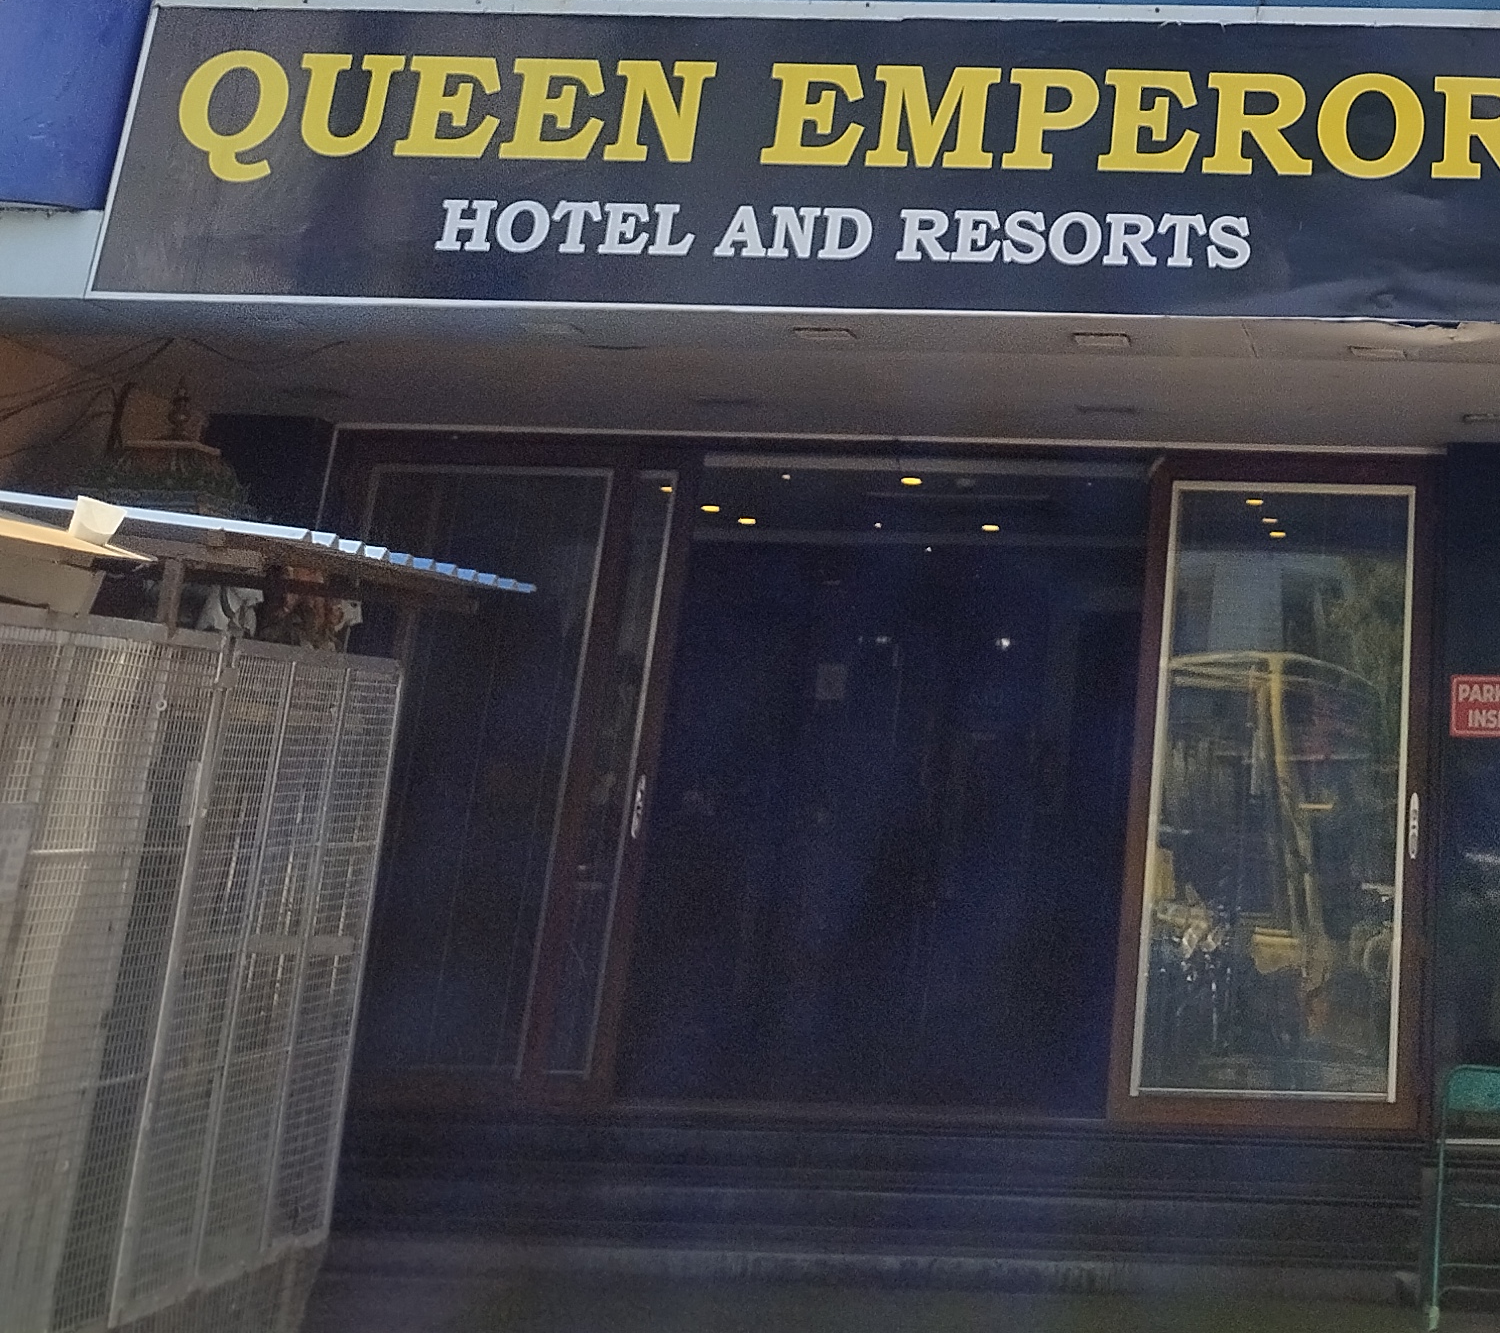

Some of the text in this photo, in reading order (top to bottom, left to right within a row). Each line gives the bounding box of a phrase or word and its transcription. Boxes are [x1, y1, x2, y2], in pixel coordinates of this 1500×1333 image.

[176, 48, 716, 186] QUEEN
[434, 198, 1254, 268] HOTEL AND RESORTS
